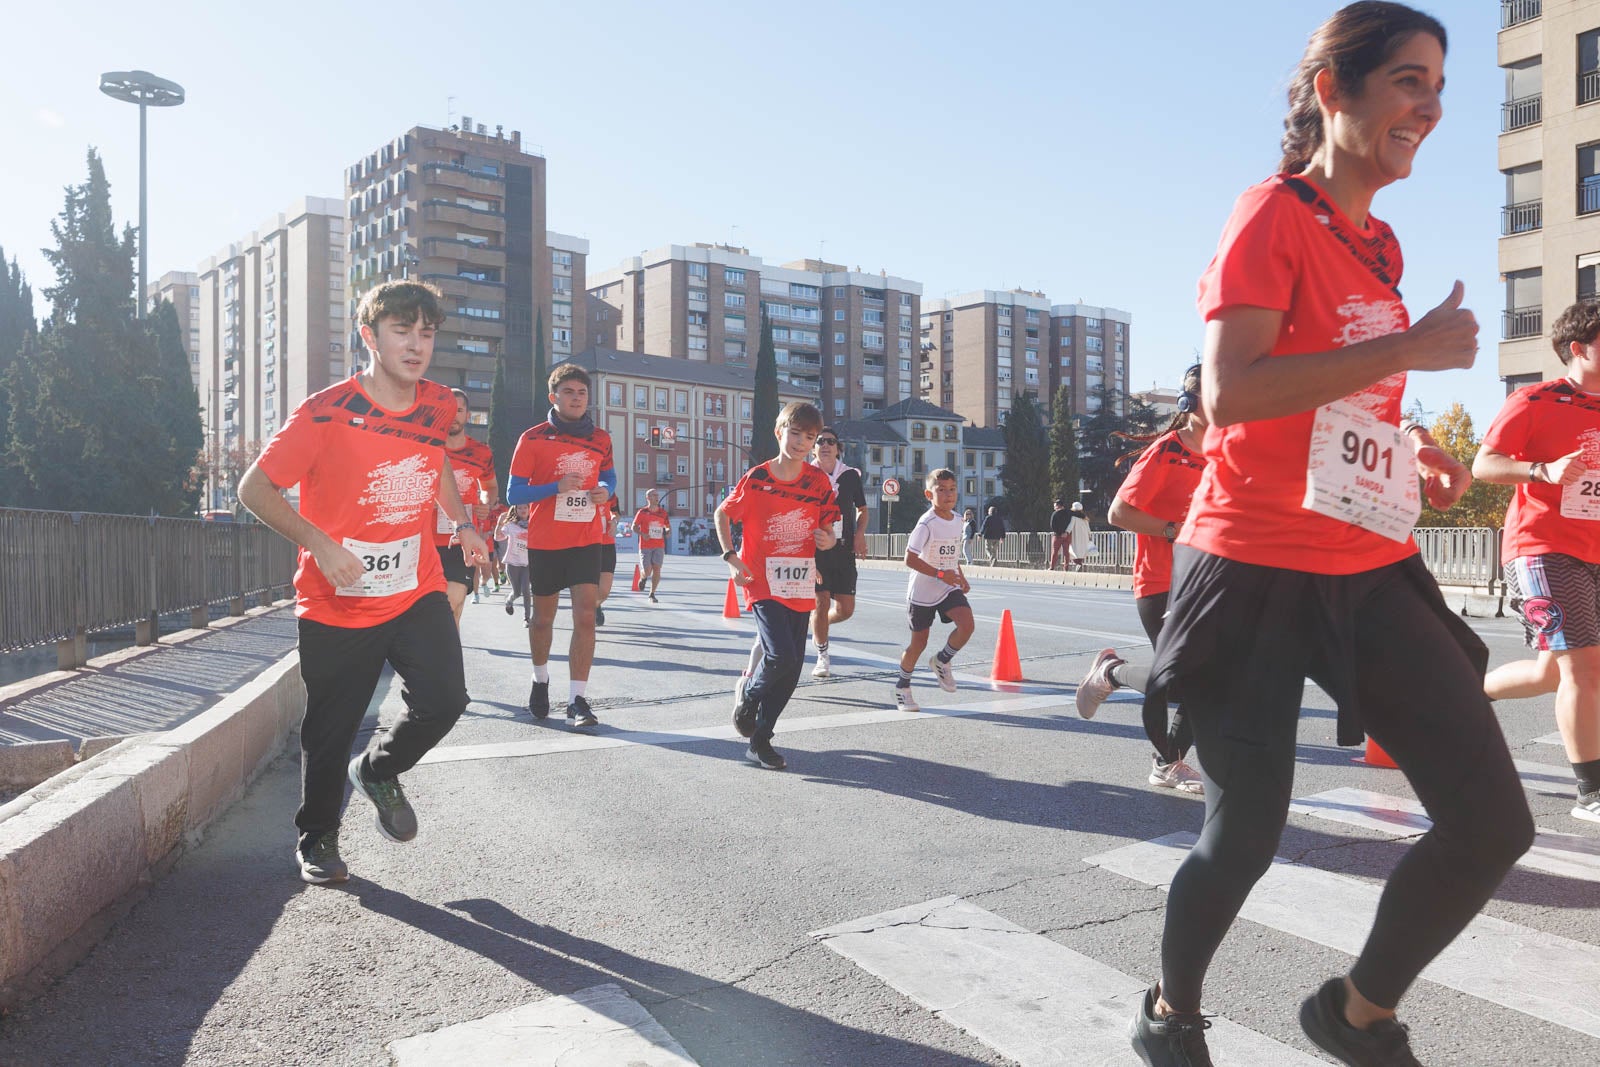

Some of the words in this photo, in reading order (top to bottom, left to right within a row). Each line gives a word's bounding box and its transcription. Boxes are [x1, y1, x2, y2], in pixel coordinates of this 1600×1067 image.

[1342, 430, 1393, 479] 901
[369, 474, 433, 492] carrera
[1355, 475, 1384, 494] SANDRA
[368, 490, 431, 504] cruzroja.es
[566, 497, 587, 507] 856
[768, 522, 810, 534] carrera
[939, 545, 956, 555] 639
[362, 551, 401, 572] 361
[774, 566, 809, 580] 1107
